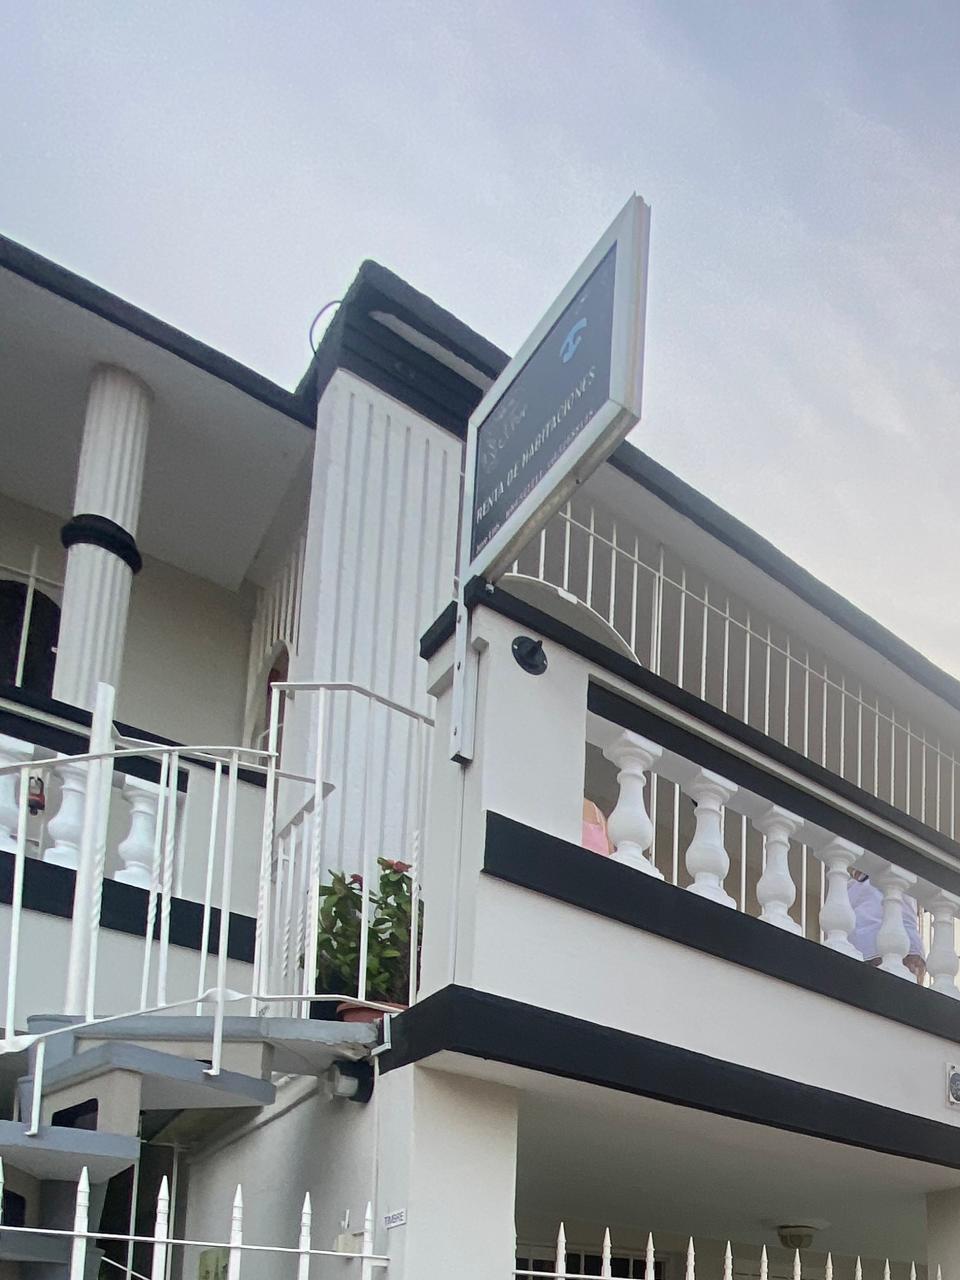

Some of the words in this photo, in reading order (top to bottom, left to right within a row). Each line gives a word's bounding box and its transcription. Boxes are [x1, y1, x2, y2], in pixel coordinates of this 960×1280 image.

[476, 481, 504, 524] RENTA
[507, 462, 519, 487] DE
[521, 366, 596, 468] HABITACIONES
